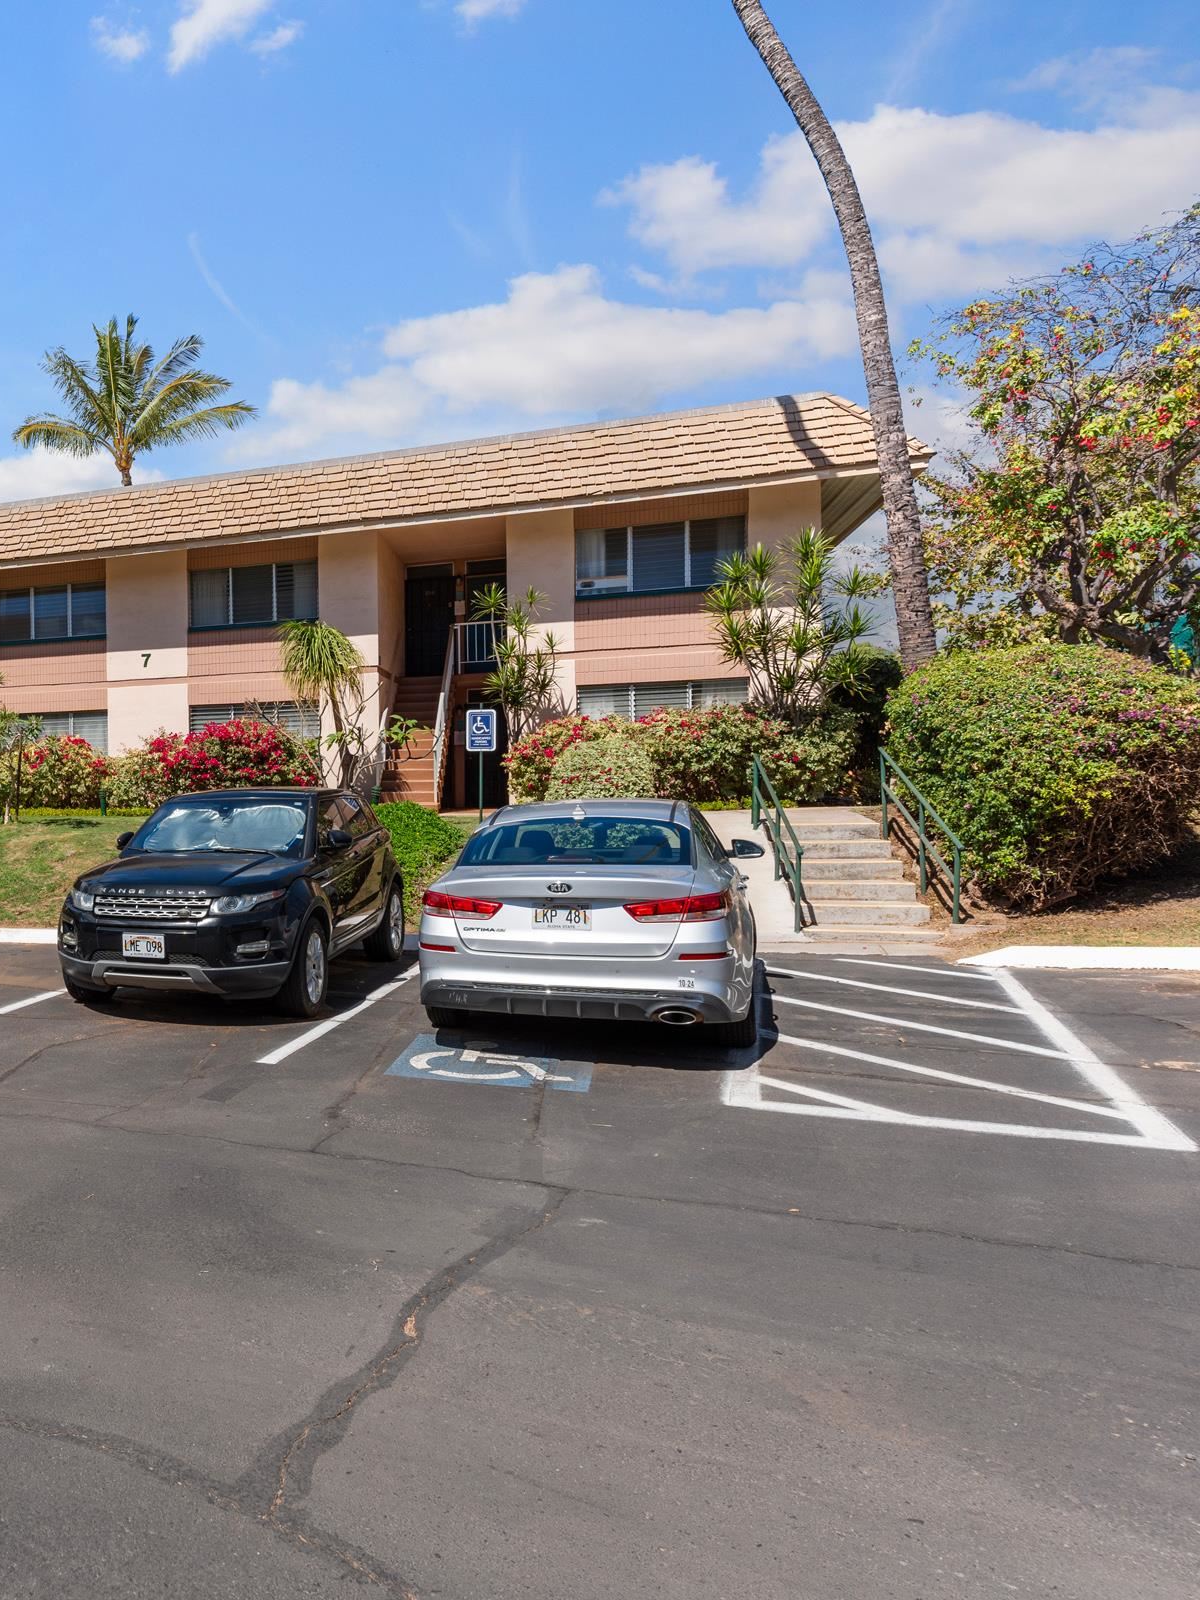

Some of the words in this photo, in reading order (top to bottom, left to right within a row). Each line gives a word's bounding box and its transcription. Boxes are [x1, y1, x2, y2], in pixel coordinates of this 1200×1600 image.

[141, 653, 152, 668] 7
[550, 884, 569, 892] KIA
[534, 909, 558, 923] LKP
[565, 909, 587, 924] 481
[124, 939, 141, 952] LME
[146, 940, 163, 953] 098
